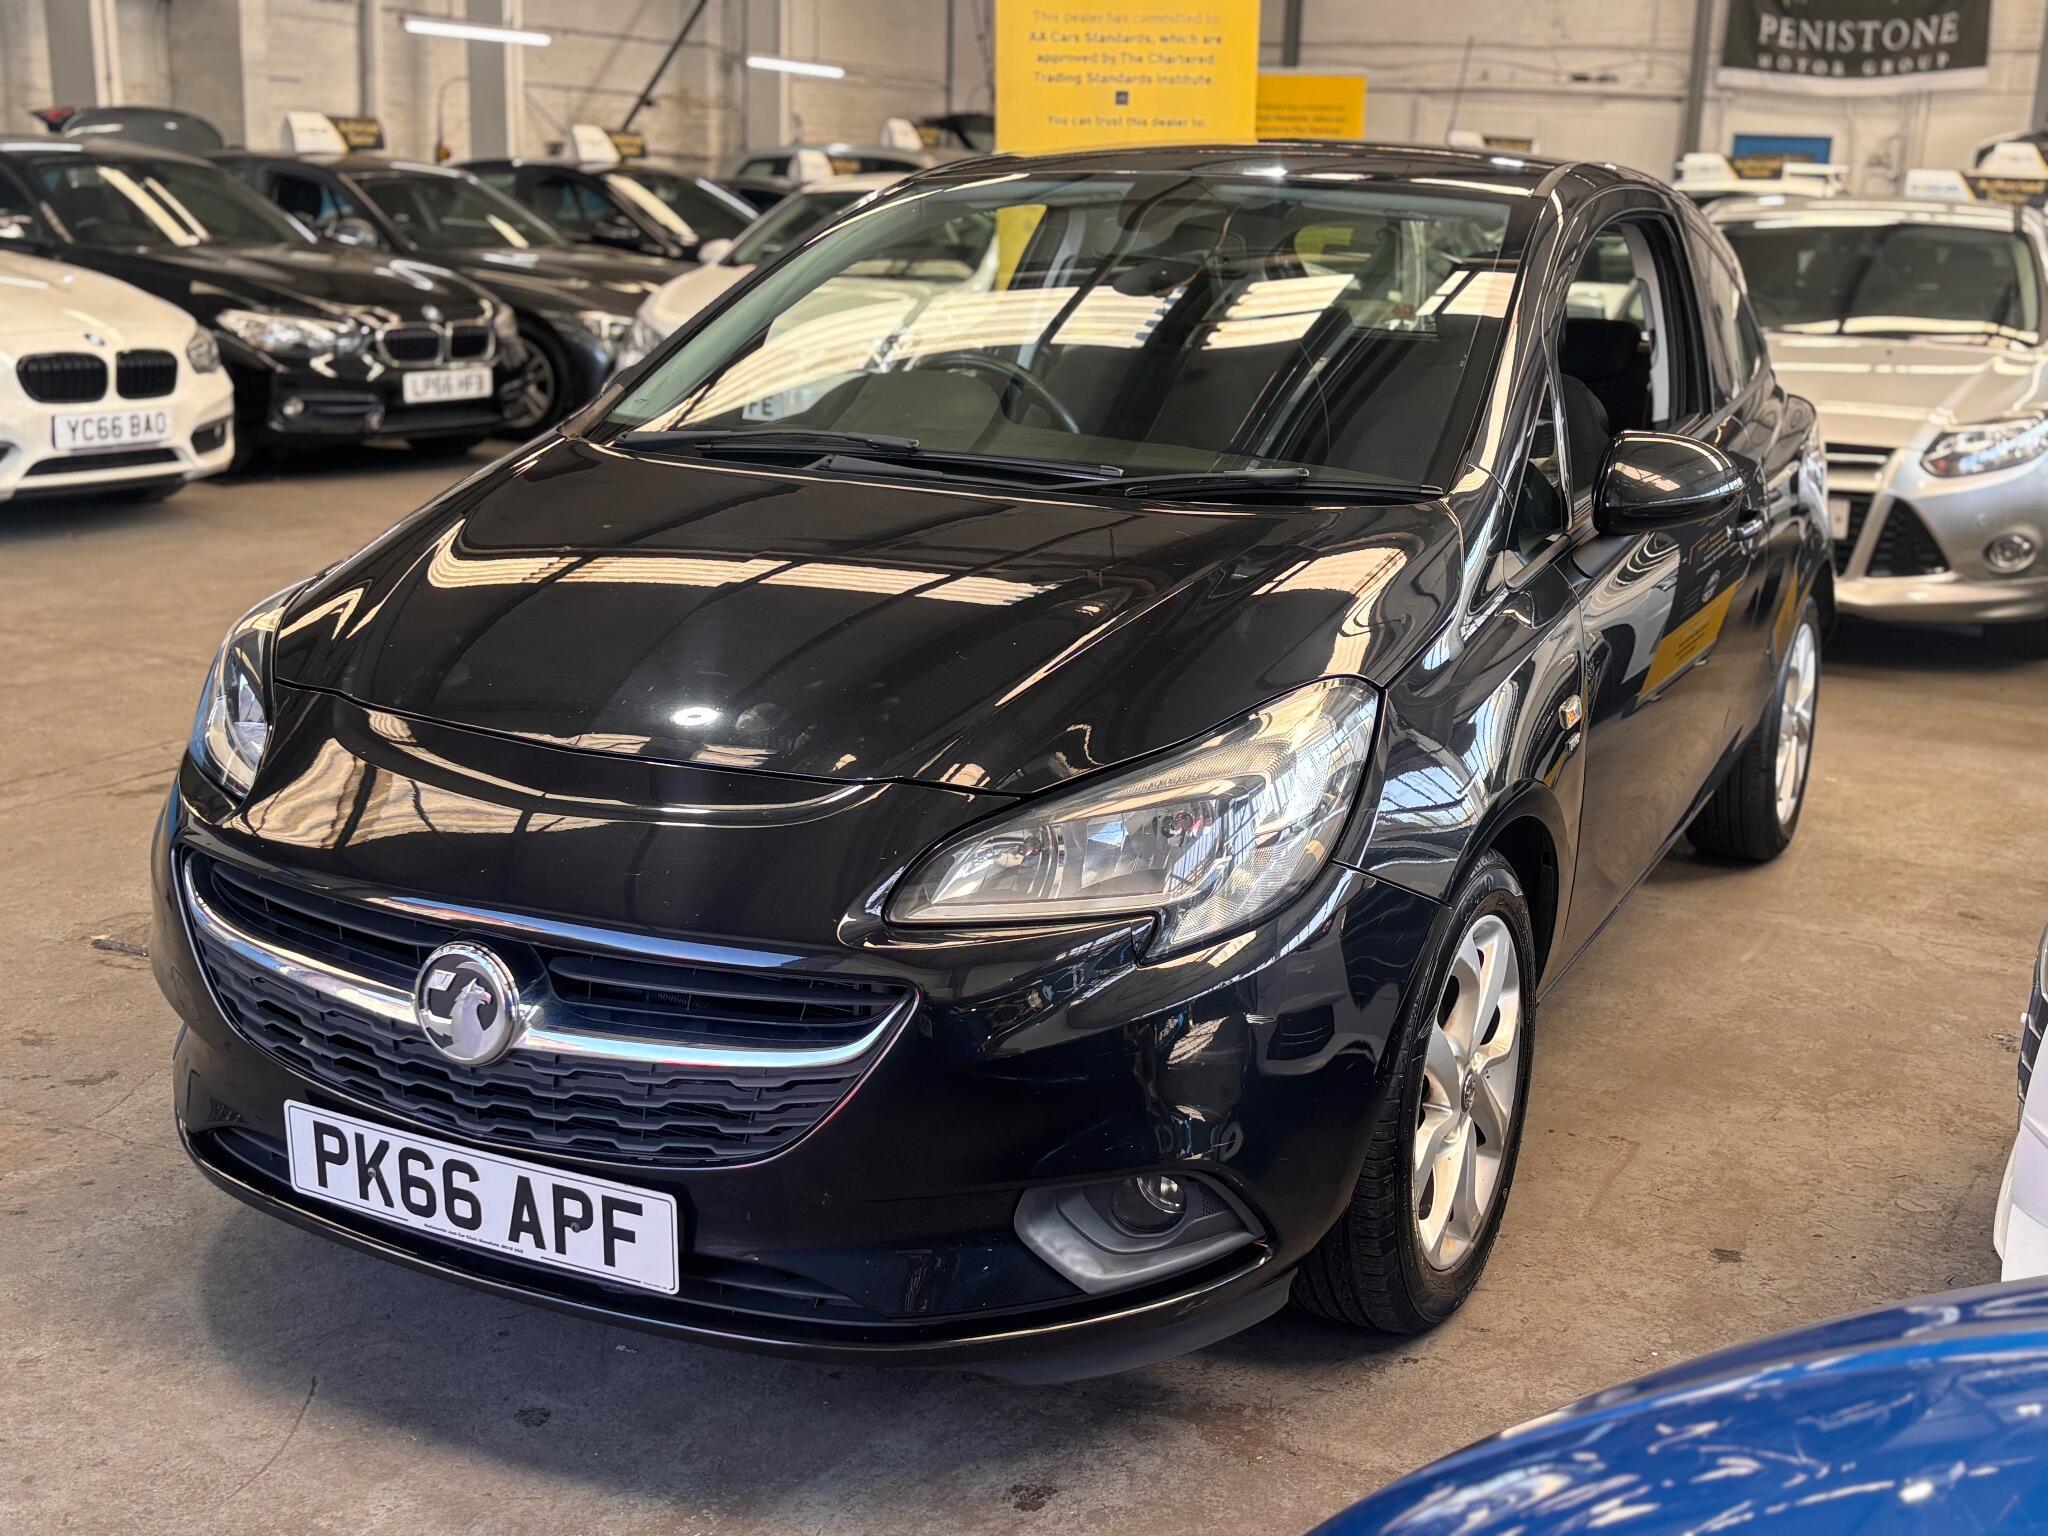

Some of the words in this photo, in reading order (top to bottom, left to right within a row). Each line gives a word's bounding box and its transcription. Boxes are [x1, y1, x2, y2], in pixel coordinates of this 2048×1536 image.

[1028, 31, 1047, 43] AA
[1051, 31, 1080, 44] Cars
[1160, 32, 1199, 45] which
[1202, 35, 1223, 45] are
[1758, 11, 1959, 53] PENISTONE
[1036, 53, 1098, 66] approved
[1101, 52, 1117, 66] by
[1120, 52, 1143, 65] The
[1147, 53, 1215, 66] Chartered
[1757, 52, 1846, 77] MOTOR
[1861, 51, 1950, 77] GROUP
[1034, 71, 1083, 86] Trading
[1086, 72, 1152, 85] Standards
[1047, 115, 1069, 126] You
[1071, 117, 1092, 126] can
[1094, 116, 1123, 127] trust
[1126, 117, 1148, 127] this
[1151, 117, 1189, 128] dealer
[67, 415, 123, 442] YC66
[312, 1119, 483, 1231] PK66
[507, 1174, 644, 1268] APF
